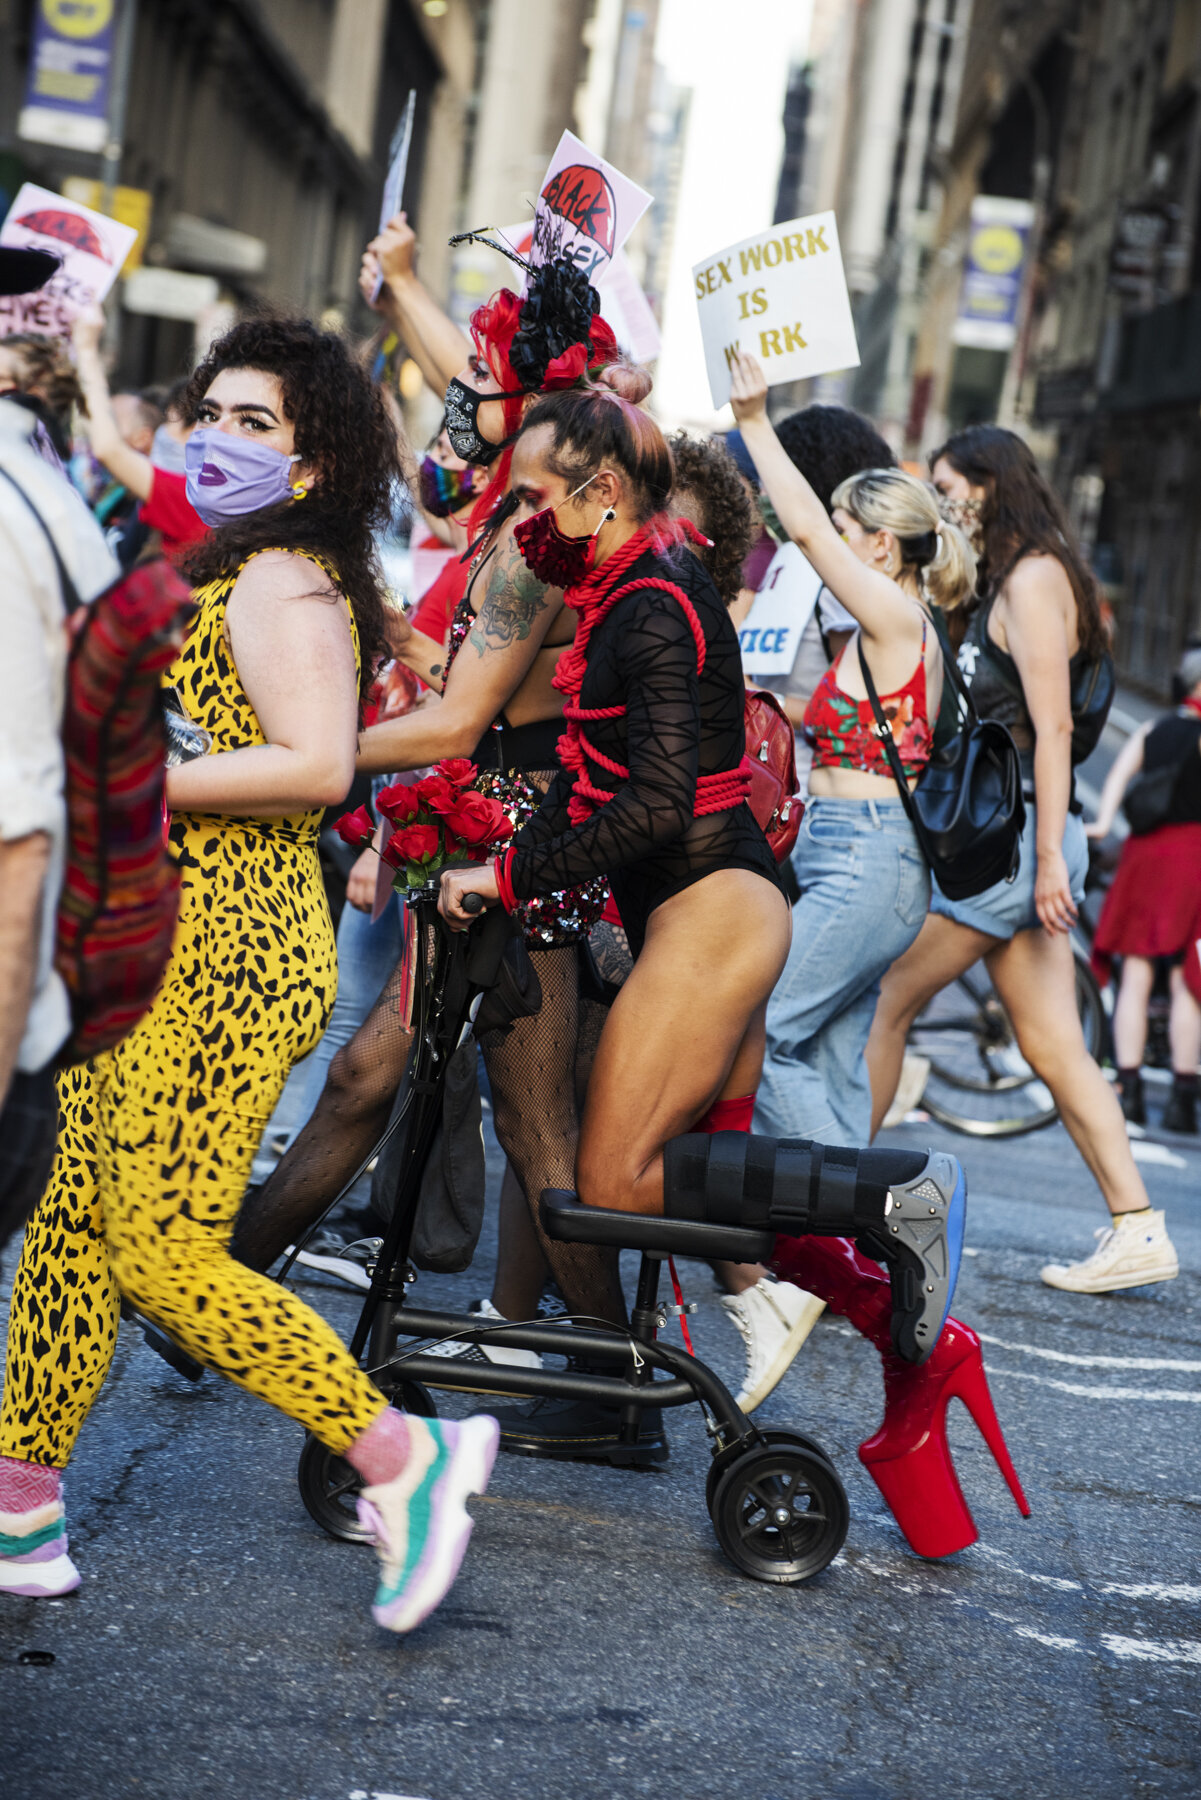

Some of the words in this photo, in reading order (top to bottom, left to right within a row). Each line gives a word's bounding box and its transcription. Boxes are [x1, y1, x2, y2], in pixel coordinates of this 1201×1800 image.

[545, 172, 607, 238] BLACK
[696, 256, 733, 300] SEX
[739, 226, 830, 276] WORK
[737, 287, 769, 320] IS
[724, 322, 808, 372] WRK
